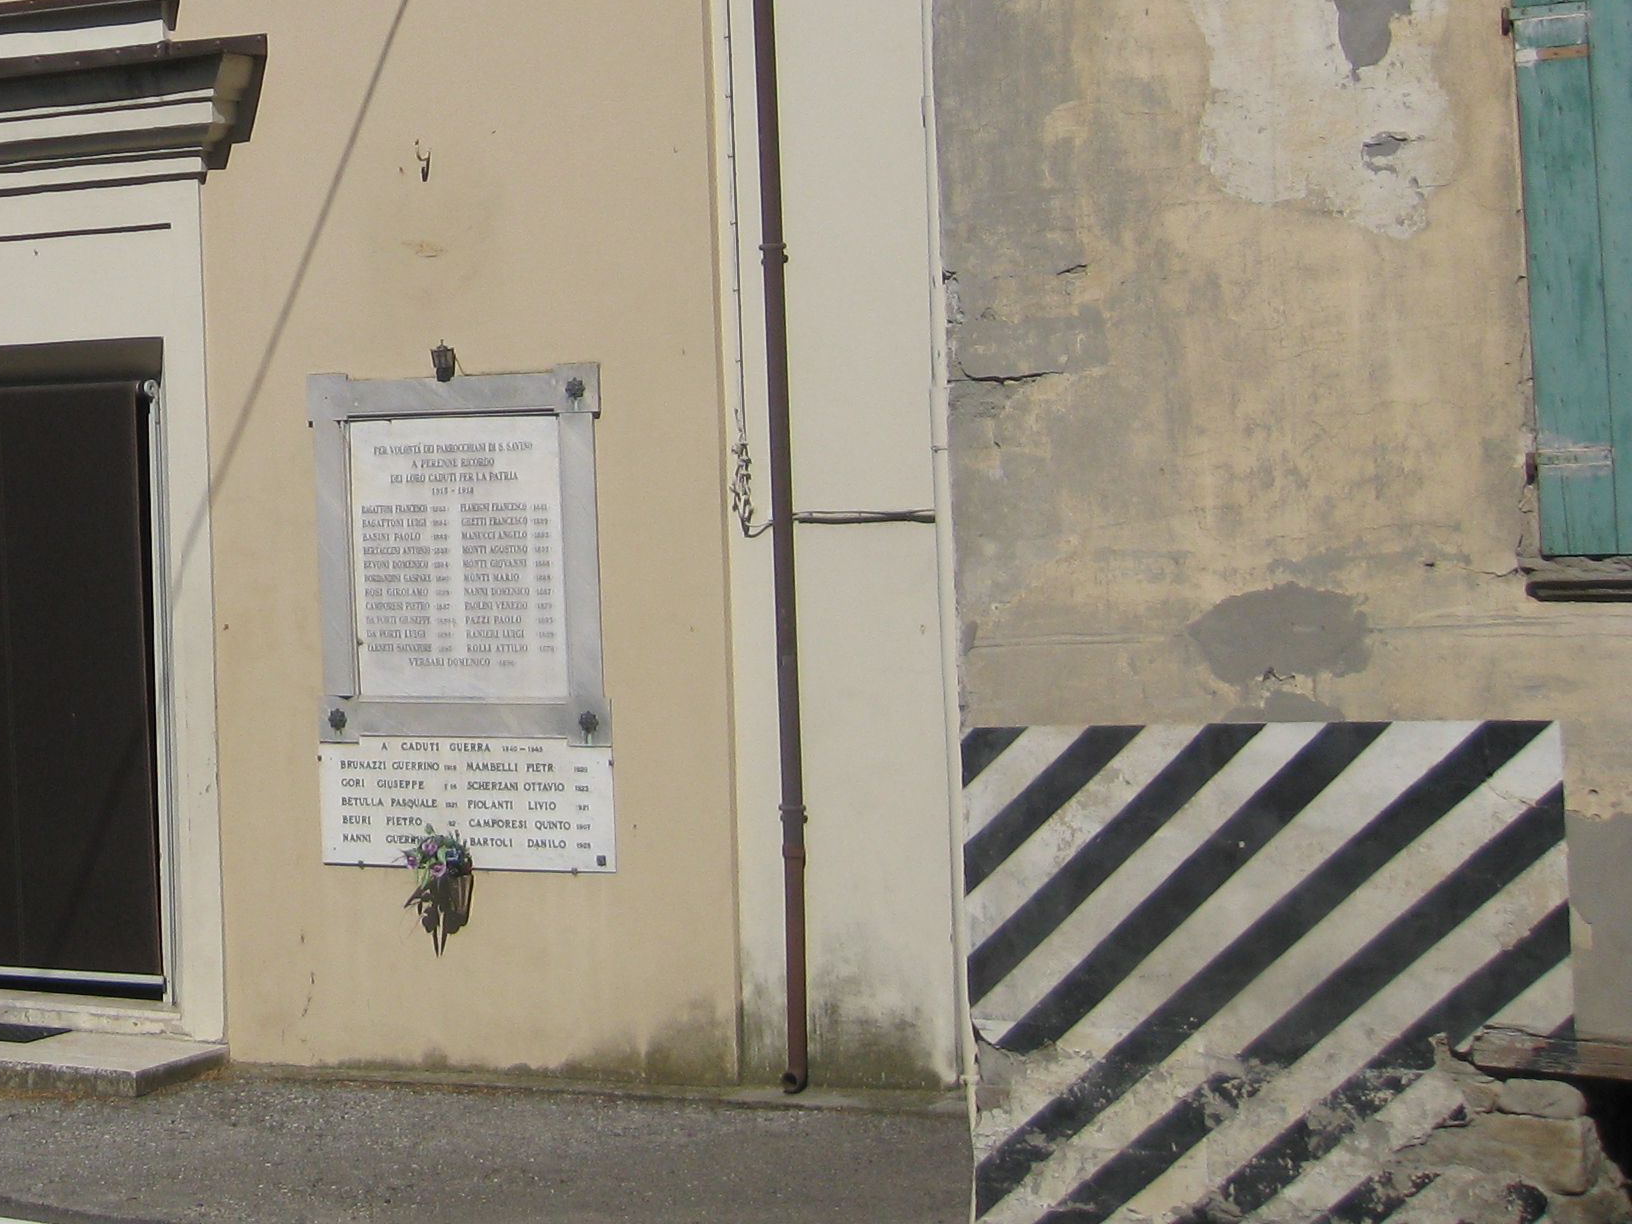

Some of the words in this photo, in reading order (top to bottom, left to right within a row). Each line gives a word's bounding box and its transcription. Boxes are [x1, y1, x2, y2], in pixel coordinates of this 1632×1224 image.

[412, 460, 418, 468] A
[421, 459, 457, 468] PERENNE
[459, 472, 474, 482] PER
[476, 472, 487, 481] LA
[489, 471, 518, 481] PATRIA
[363, 533, 390, 542] BASINI
[394, 533, 421, 541] PAOLO
[498, 531, 527, 540] ANGELO
[492, 573, 519, 582] MARIO
[465, 615, 490, 625] PAZZI
[494, 615, 521, 624] PAOLO
[400, 742, 440, 752] CADUTI
[449, 742, 491, 752] GUERRA
[340, 760, 386, 771] BRUNAZZI
[392, 760, 440, 772] GUERRINO
[466, 762, 518, 772] MAMBELLI
[341, 778, 365, 788] GORI
[376, 779, 425, 790] GIUSEPPE
[466, 780, 518, 792] SCHERZANI
[524, 780, 566, 792] OTTAVIO
[341, 797, 384, 808] BETULLA
[390, 798, 438, 809] PASQUALE
[528, 800, 556, 811] LIVIO
[386, 816, 422, 826] PIETRO
[468, 818, 528, 830] CAMPORESI
[534, 820, 571, 831] QUINTO
[342, 834, 372, 844] NANNI
[470, 837, 513, 848] BARTOLI
[527, 838, 566, 850] DANILO
